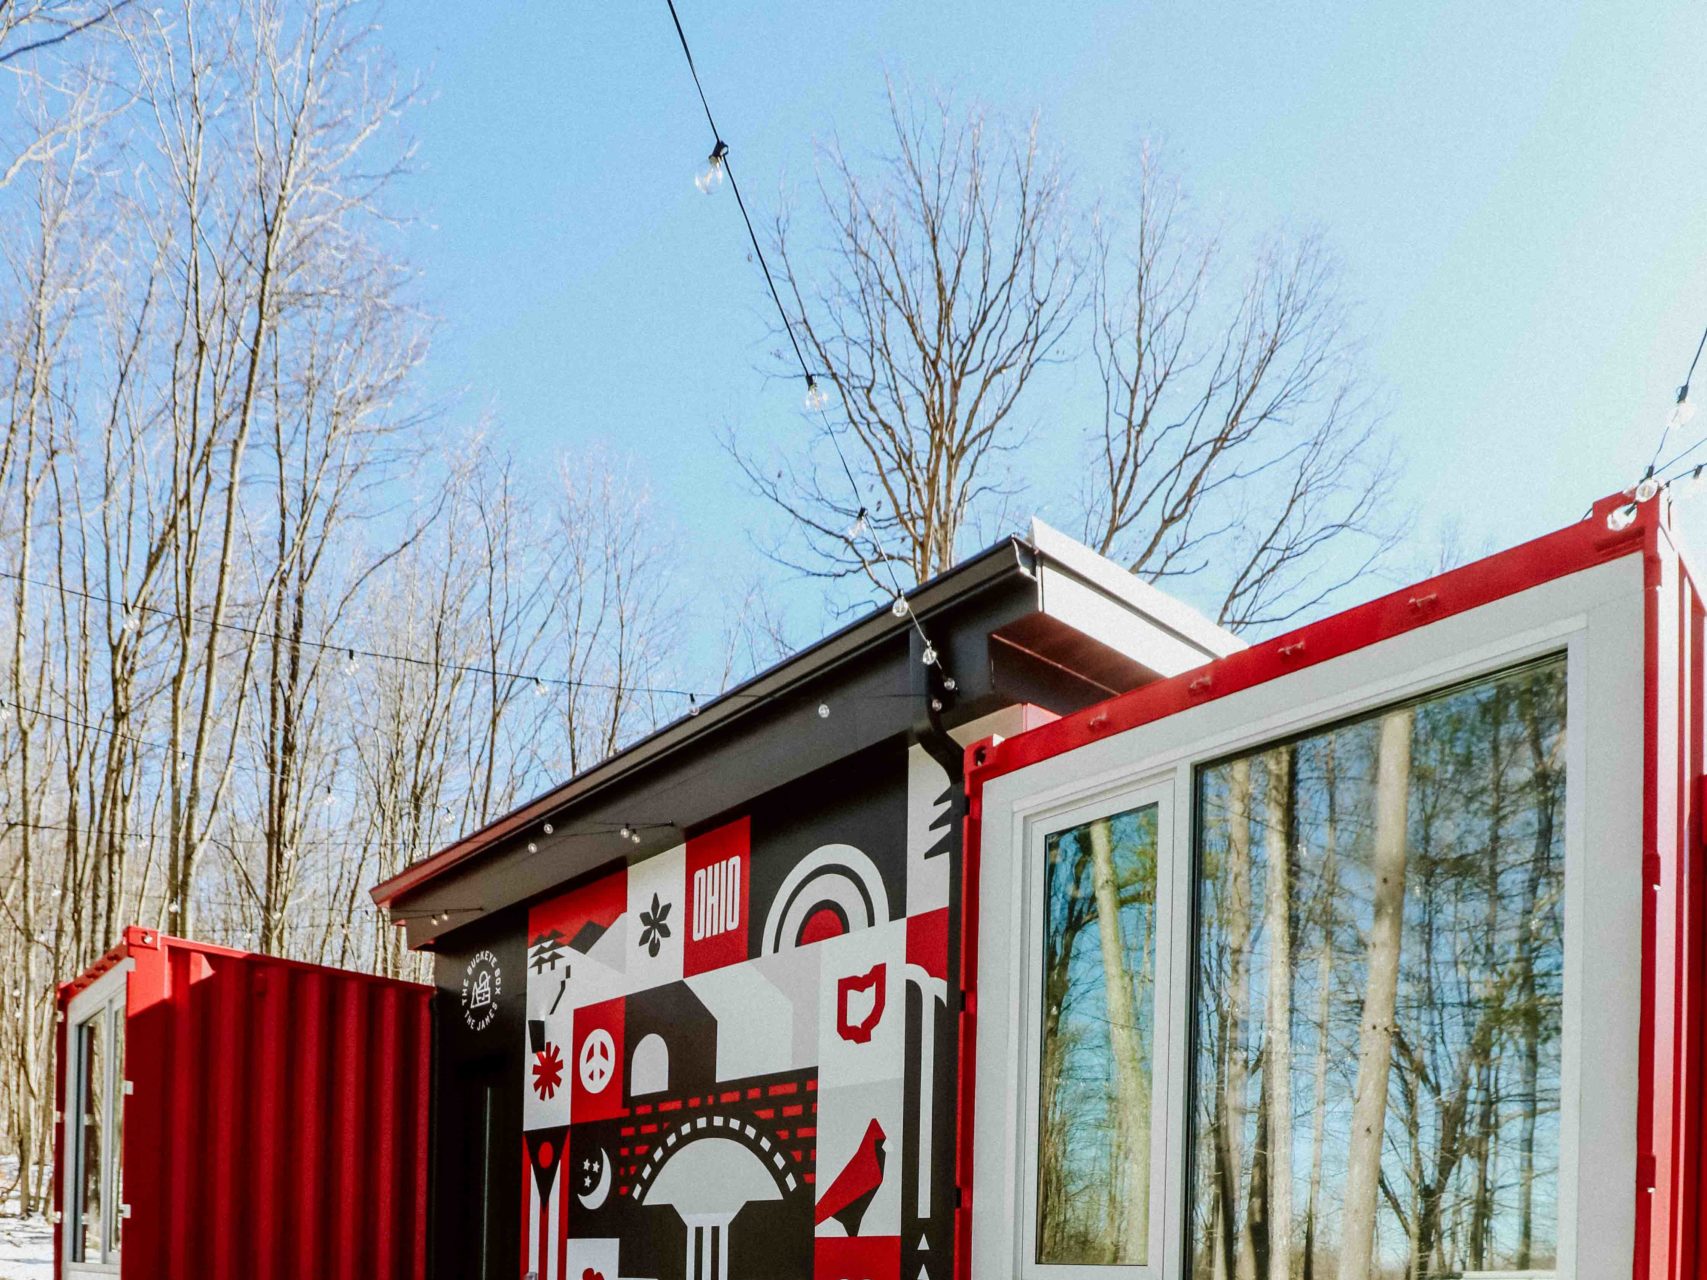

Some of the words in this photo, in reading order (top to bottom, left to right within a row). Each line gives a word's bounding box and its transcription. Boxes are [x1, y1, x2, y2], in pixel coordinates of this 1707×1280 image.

[692, 855, 741, 942] OHIO
[461, 979, 469, 1006] THE
[467, 950, 498, 975] BUCKEYE
[464, 1010, 475, 1029] THE
[477, 1002, 498, 1031] JAMES
